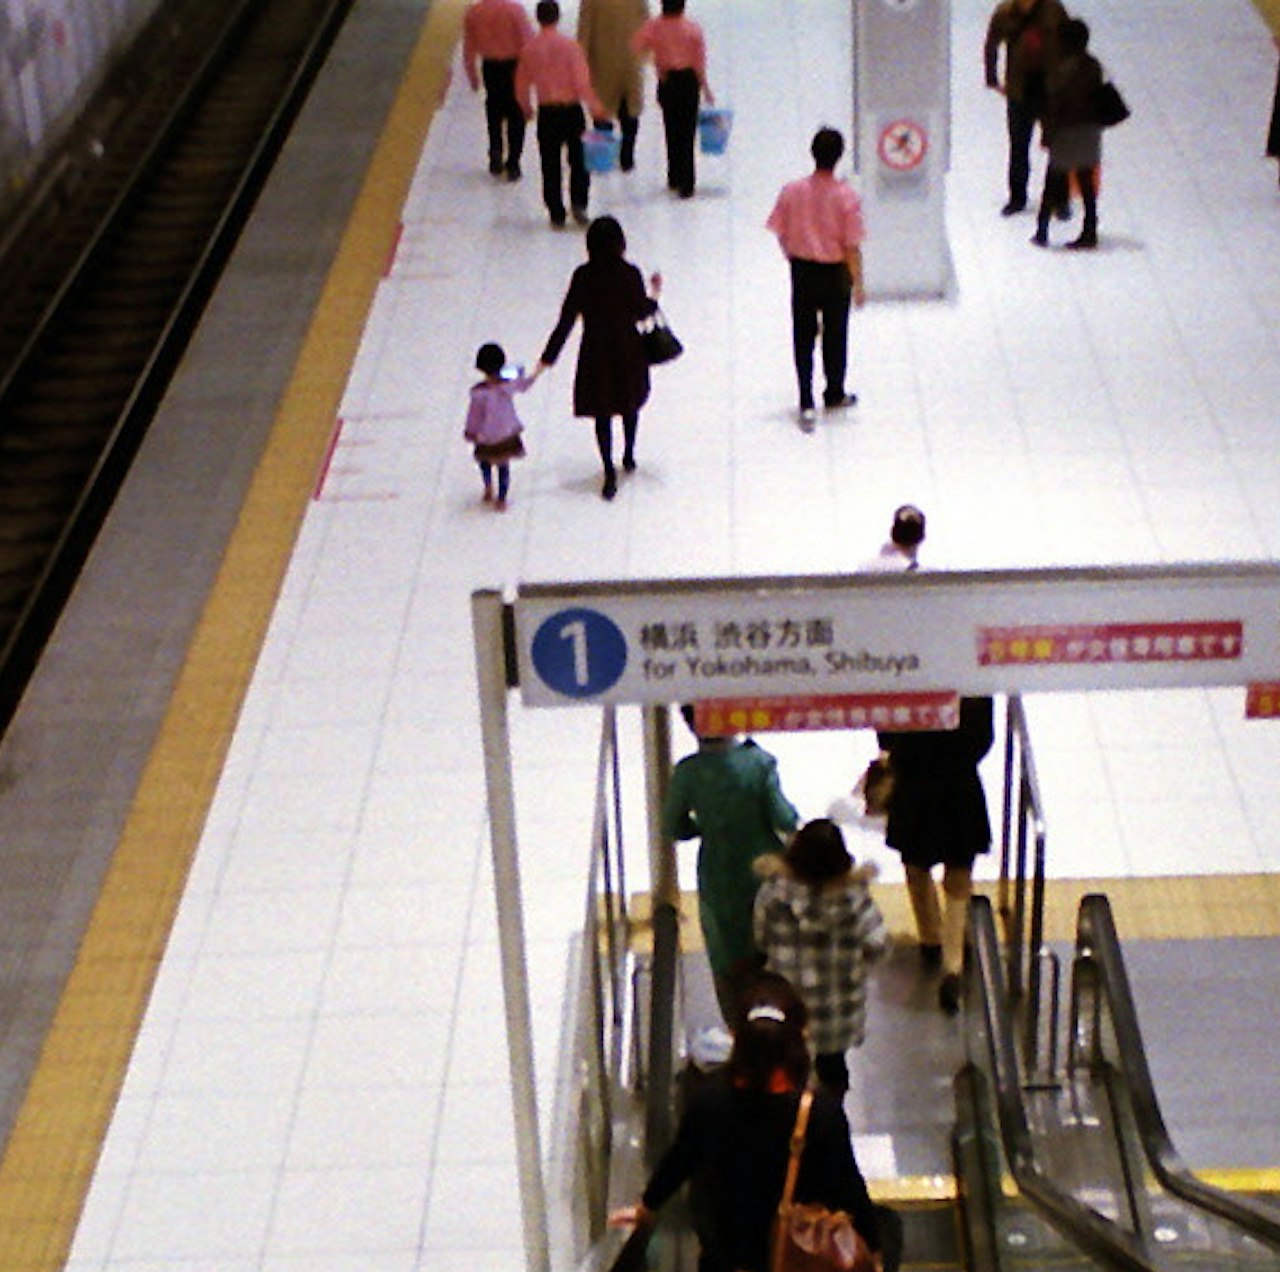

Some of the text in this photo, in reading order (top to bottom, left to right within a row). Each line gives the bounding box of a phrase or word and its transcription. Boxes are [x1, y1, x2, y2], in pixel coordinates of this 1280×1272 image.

[641, 621, 699, 650] 横浜
[559, 620, 589, 687] 1
[643, 650, 920, 680] for Yokohama, Shibuya
